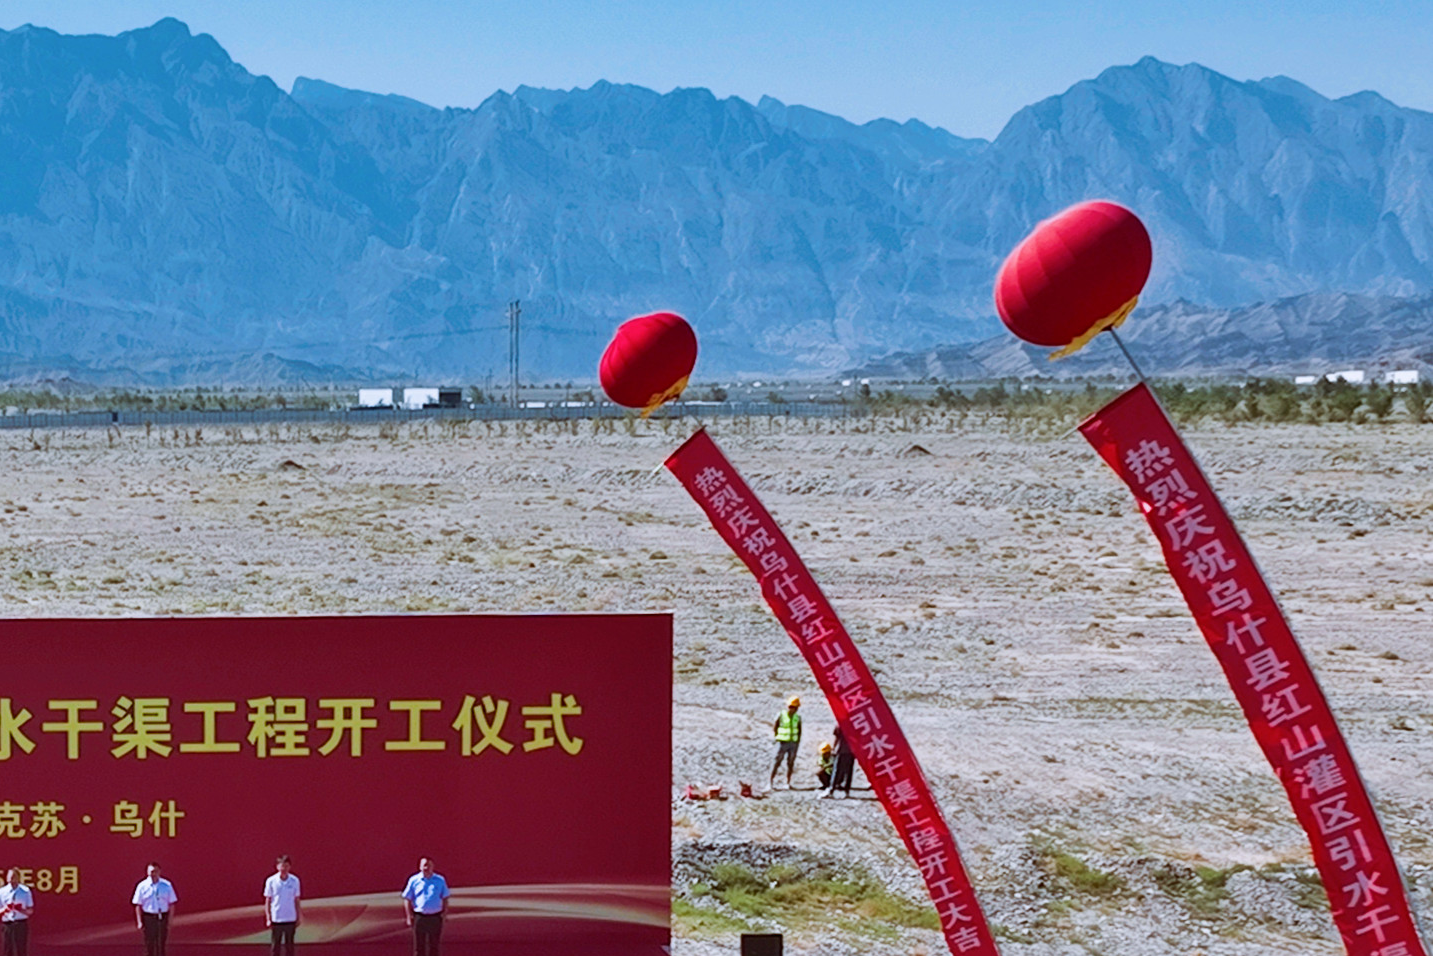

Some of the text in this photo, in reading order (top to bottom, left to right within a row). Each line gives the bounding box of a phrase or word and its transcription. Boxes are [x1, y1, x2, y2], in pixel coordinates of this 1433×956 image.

[694, 466, 982, 953] 热烈庆祝乌什县红山灌区引水干渠工程开工大吉
